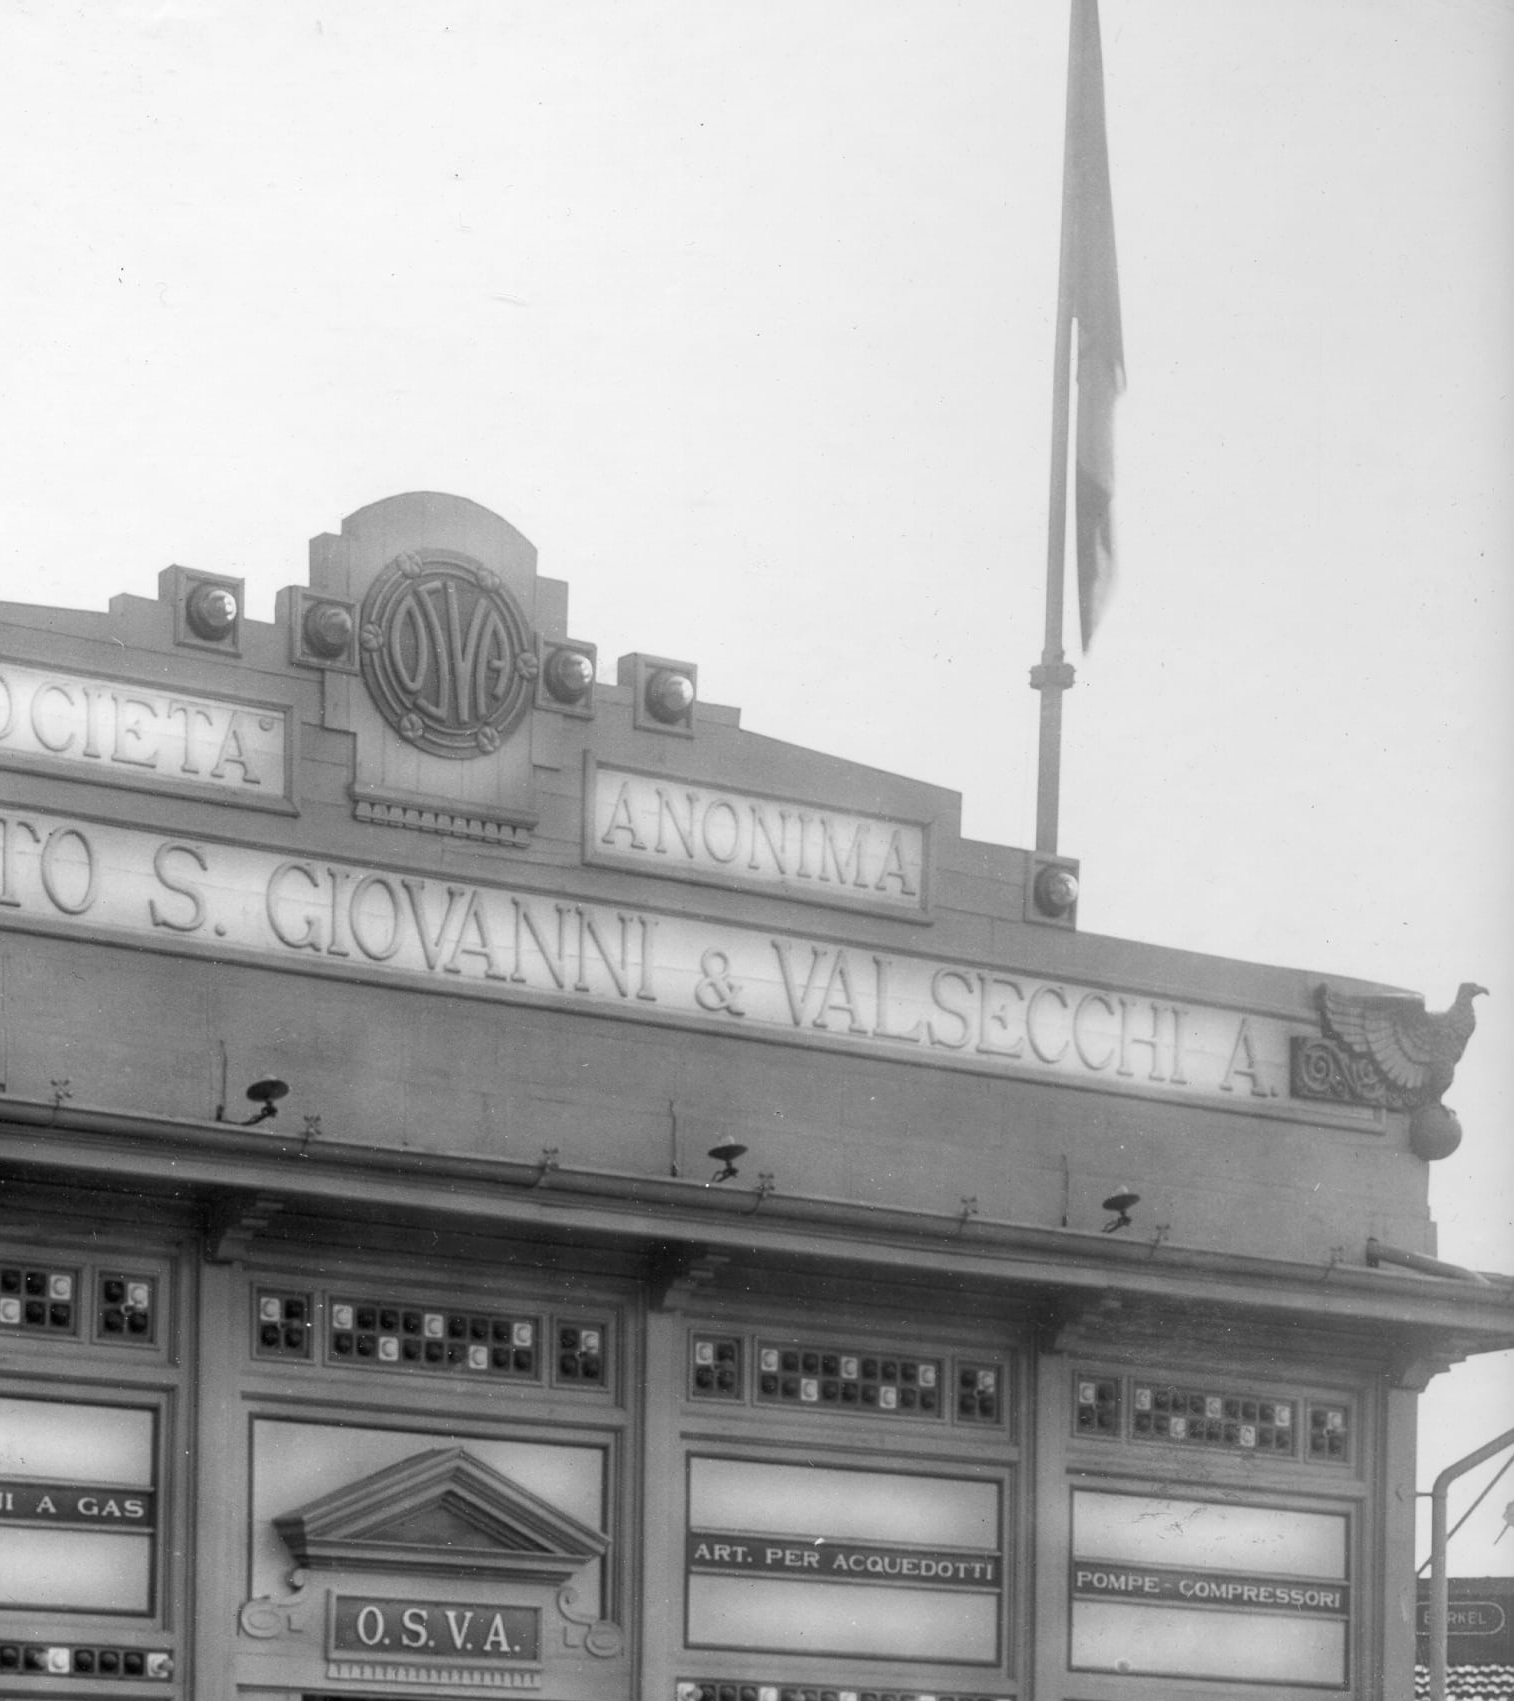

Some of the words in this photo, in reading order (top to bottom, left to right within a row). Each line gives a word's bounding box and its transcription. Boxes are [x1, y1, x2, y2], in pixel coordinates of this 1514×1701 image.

[601, 780, 917, 898] ANONIMA
[150, 840, 227, 938] S.
[266, 860, 658, 1002] GIOVANNI
[694, 947, 746, 1019] &
[770, 938, 1189, 1088] VALSECCHI
[1219, 1016, 1280, 1099] A.
[36, 1495, 58, 1514] A
[77, 1497, 145, 1519] GAS
[693, 1543, 753, 1564] ART.
[765, 1547, 821, 1568] PER
[832, 1553, 995, 1581] ACQUEDOTTI
[1076, 1571, 1161, 1593] POMPE
[1179, 1580, 1341, 1608] COMPRESSORI
[356, 1605, 522, 1653] O.S.V.A.
[1424, 1610, 1488, 1626] BRKEL
